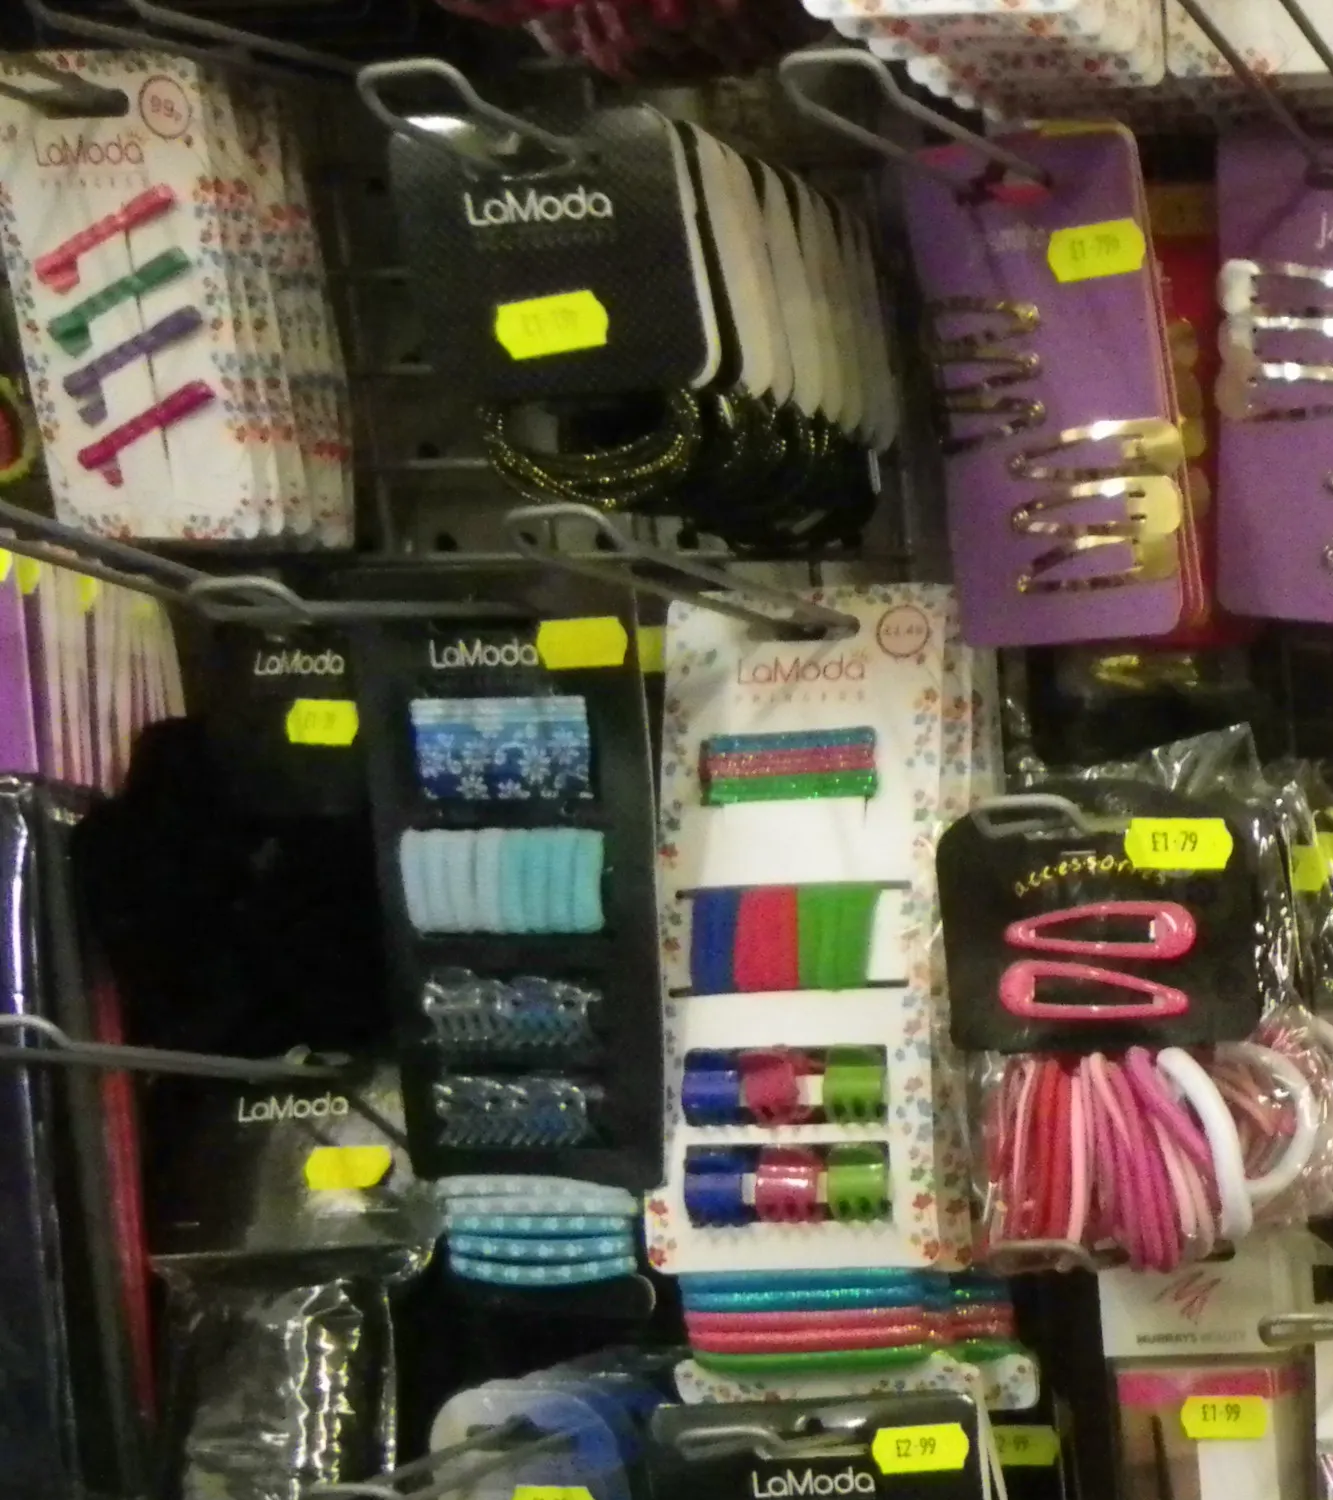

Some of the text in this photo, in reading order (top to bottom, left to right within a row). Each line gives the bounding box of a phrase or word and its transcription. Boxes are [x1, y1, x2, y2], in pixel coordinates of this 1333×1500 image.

[33, 133, 145, 169] LaModa
[465, 190, 613, 228] LaModa
[253, 648, 345, 678] LaModa
[429, 636, 539, 671] LaModa
[736, 651, 868, 685] LaModa
[1149, 831, 1199, 855] £1.79
[238, 1093, 350, 1124] LaModa
[894, 1436, 938, 1459] £2.99
[999, 1435, 1031, 1455] 2.99
[750, 1466, 877, 1500] LaModa
